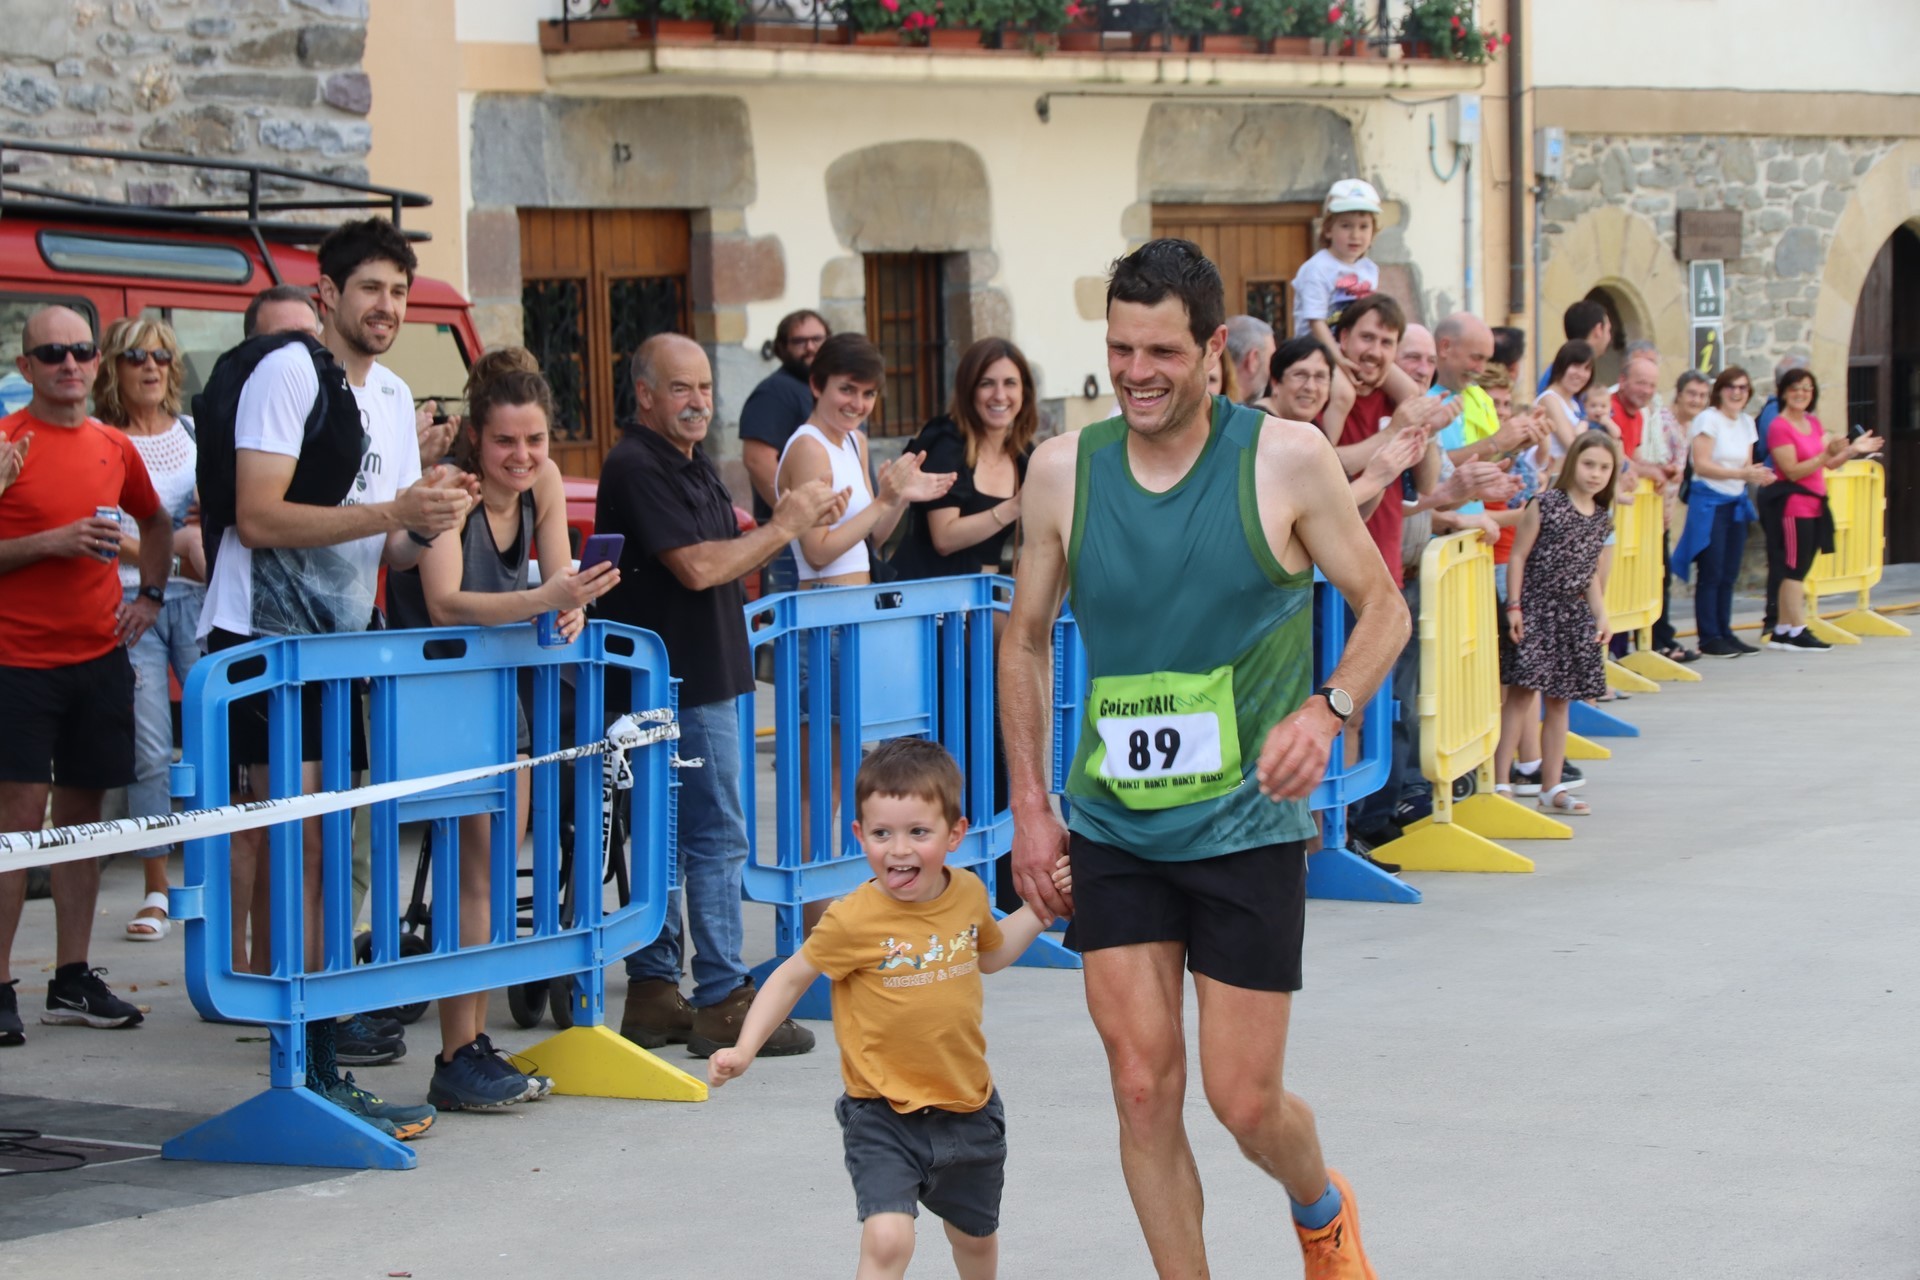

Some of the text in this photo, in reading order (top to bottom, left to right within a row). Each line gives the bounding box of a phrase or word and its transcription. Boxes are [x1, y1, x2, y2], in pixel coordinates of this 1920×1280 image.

[1128, 727, 1181, 771] 89
[883, 971, 935, 988] MICKEY
[937, 969, 947, 981] &
